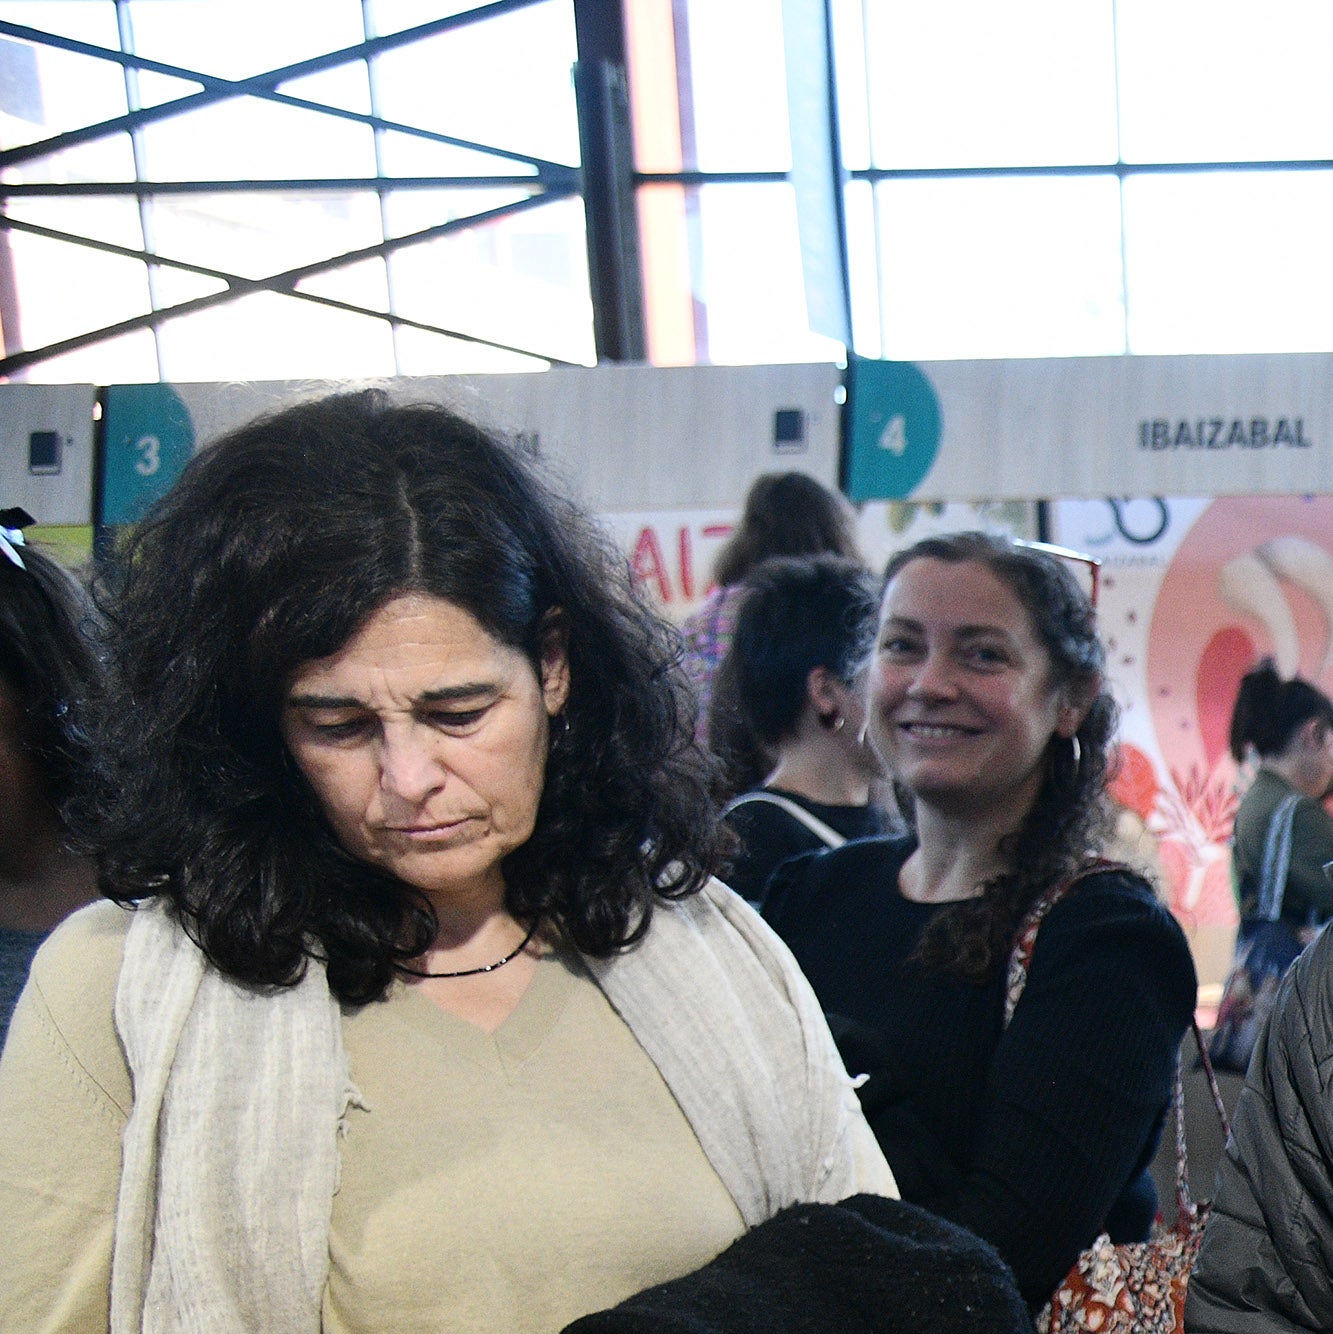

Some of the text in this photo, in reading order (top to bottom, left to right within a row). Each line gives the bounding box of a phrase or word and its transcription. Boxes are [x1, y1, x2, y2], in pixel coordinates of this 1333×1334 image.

[877, 412, 907, 456] 4
[1138, 416, 1312, 449] IBAIZABAL
[135, 435, 161, 476] 3
